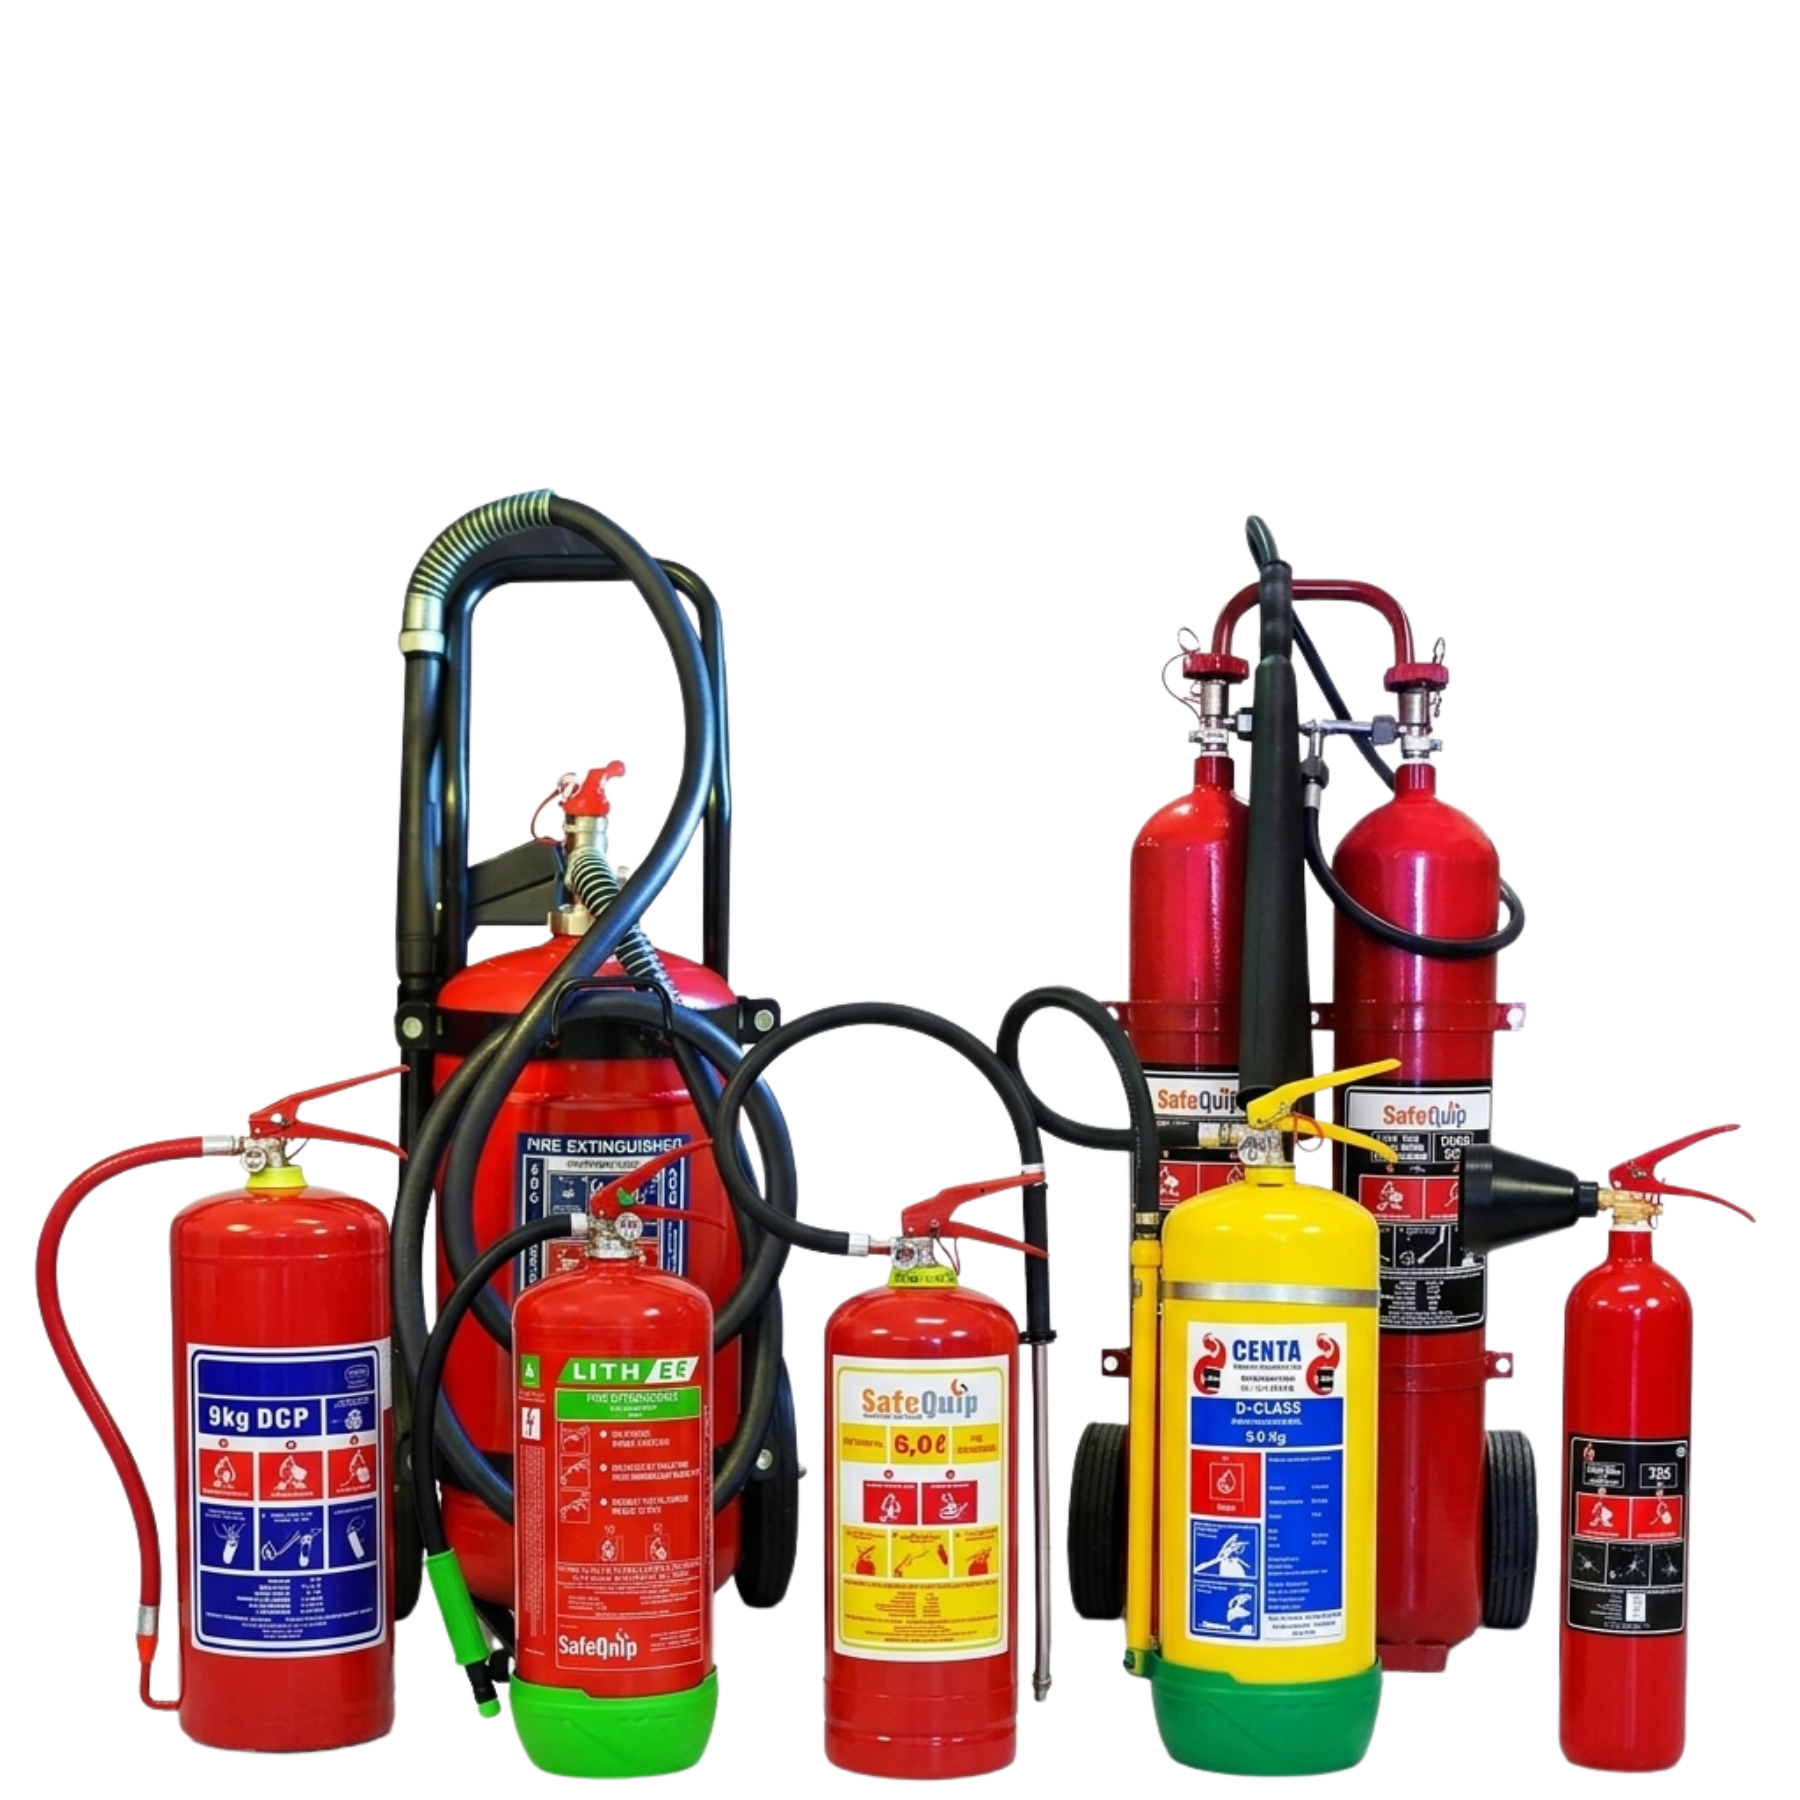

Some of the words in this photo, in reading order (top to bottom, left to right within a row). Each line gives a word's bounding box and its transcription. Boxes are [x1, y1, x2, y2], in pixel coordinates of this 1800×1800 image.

[1232, 1339, 1302, 1362] CENTA
[573, 1362, 640, 1381] LITH
[862, 1379, 978, 1418] SafeQuip
[1235, 1401, 1302, 1415] D-CLASS
[208, 1405, 249, 1433] 9kg
[257, 1407, 309, 1429] DCP
